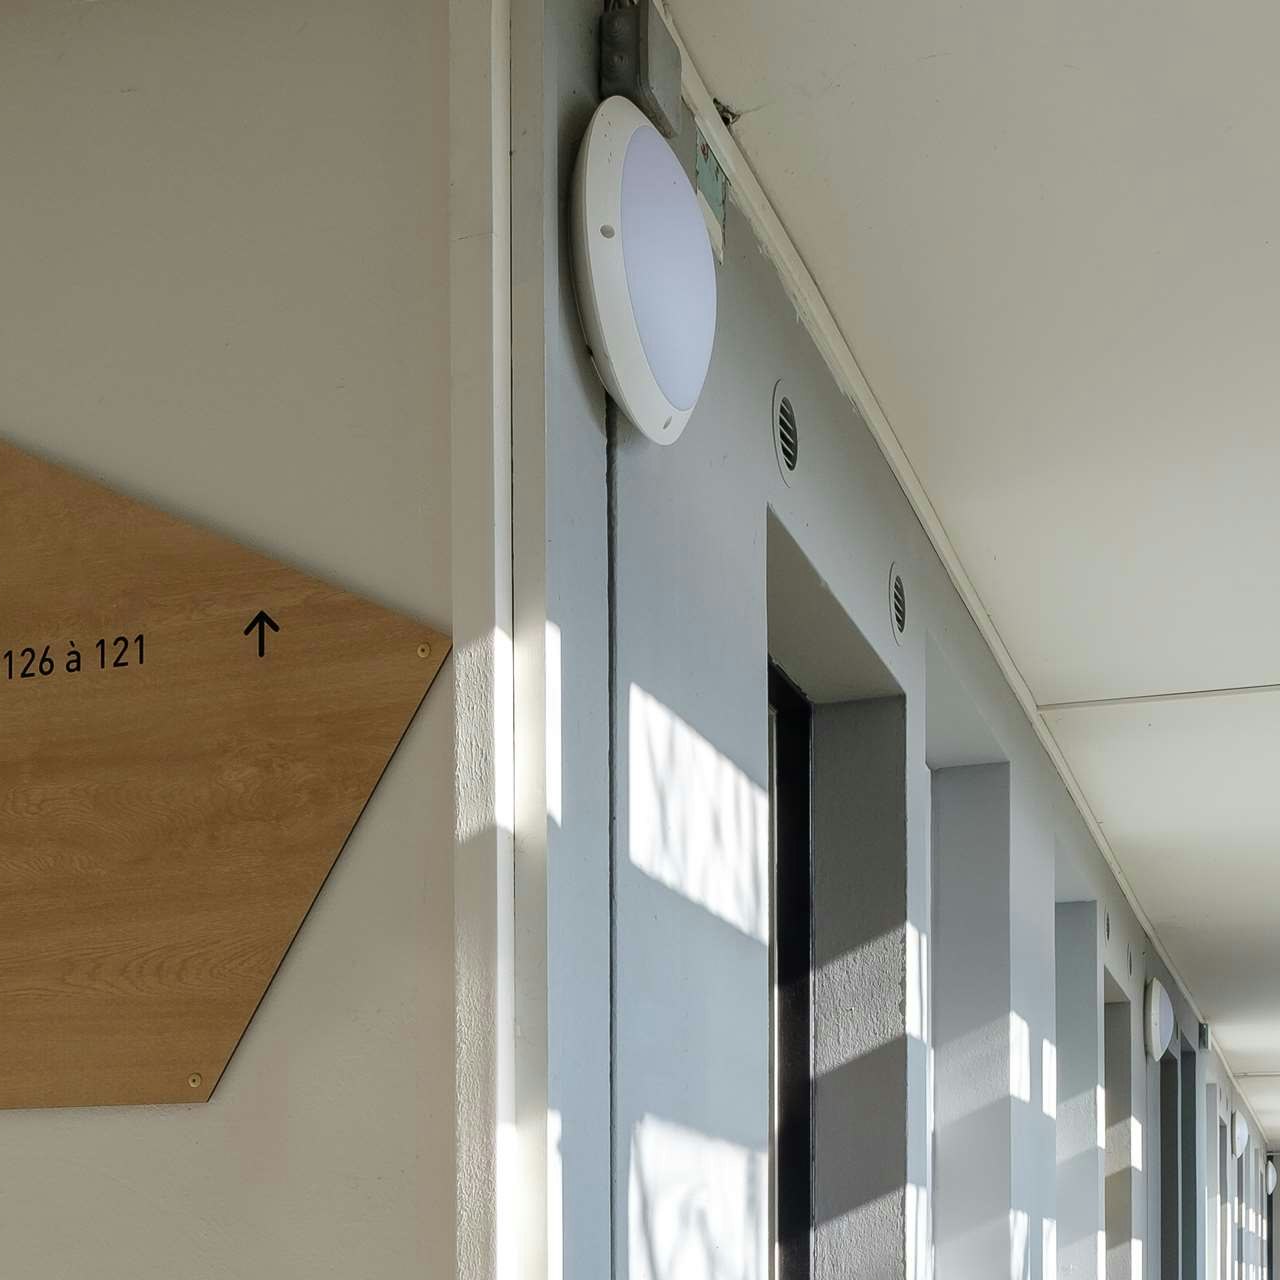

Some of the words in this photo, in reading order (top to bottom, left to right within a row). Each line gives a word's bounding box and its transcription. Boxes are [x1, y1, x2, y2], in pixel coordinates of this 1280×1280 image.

[2, 645, 55, 681] 126
[65, 640, 81, 673] à
[95, 633, 145, 670] 121
